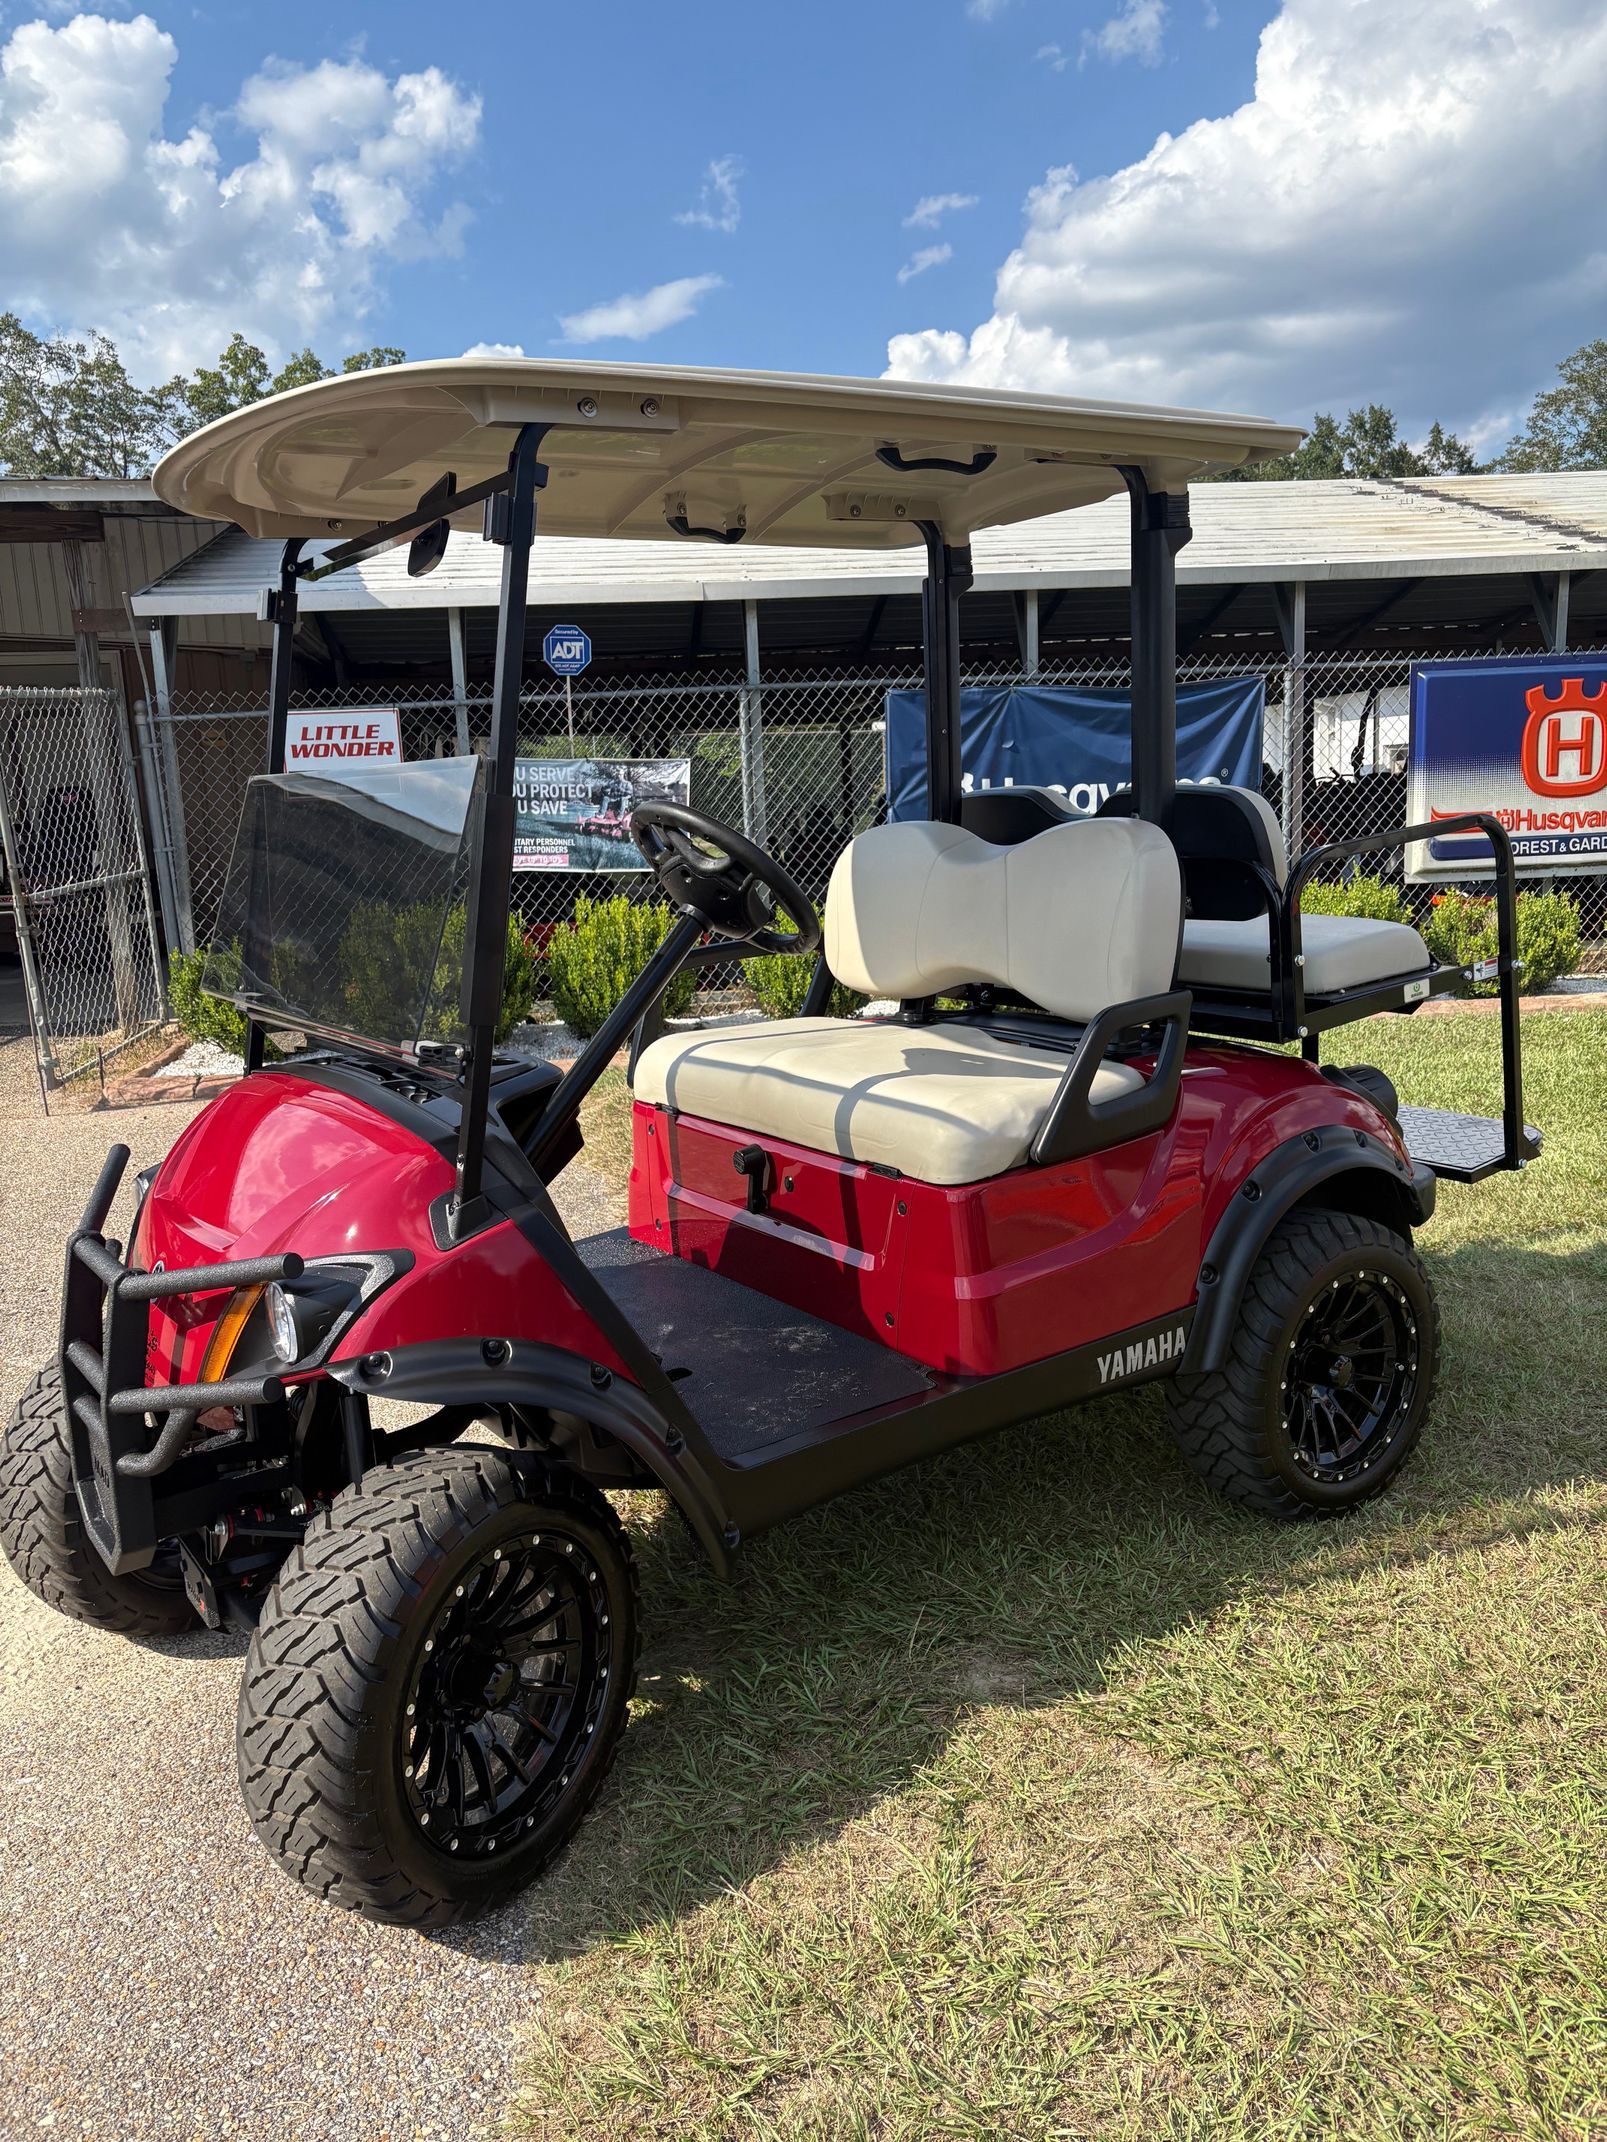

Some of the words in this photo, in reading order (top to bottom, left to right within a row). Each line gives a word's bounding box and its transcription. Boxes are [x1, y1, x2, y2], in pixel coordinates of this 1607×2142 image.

[551, 641, 583, 660] ADT
[300, 724, 381, 741] LITTLE
[290, 741, 395, 759] WONDER
[530, 783, 595, 798] PROTECT
[530, 800, 568, 815] SAVE
[523, 846, 568, 854] RESPONDERS
[535, 838, 575, 846] PERSONNEL
[1511, 839, 1559, 855] OREST
[1559, 842, 1567, 853] &
[1096, 1326, 1187, 1384] YAMAHA
